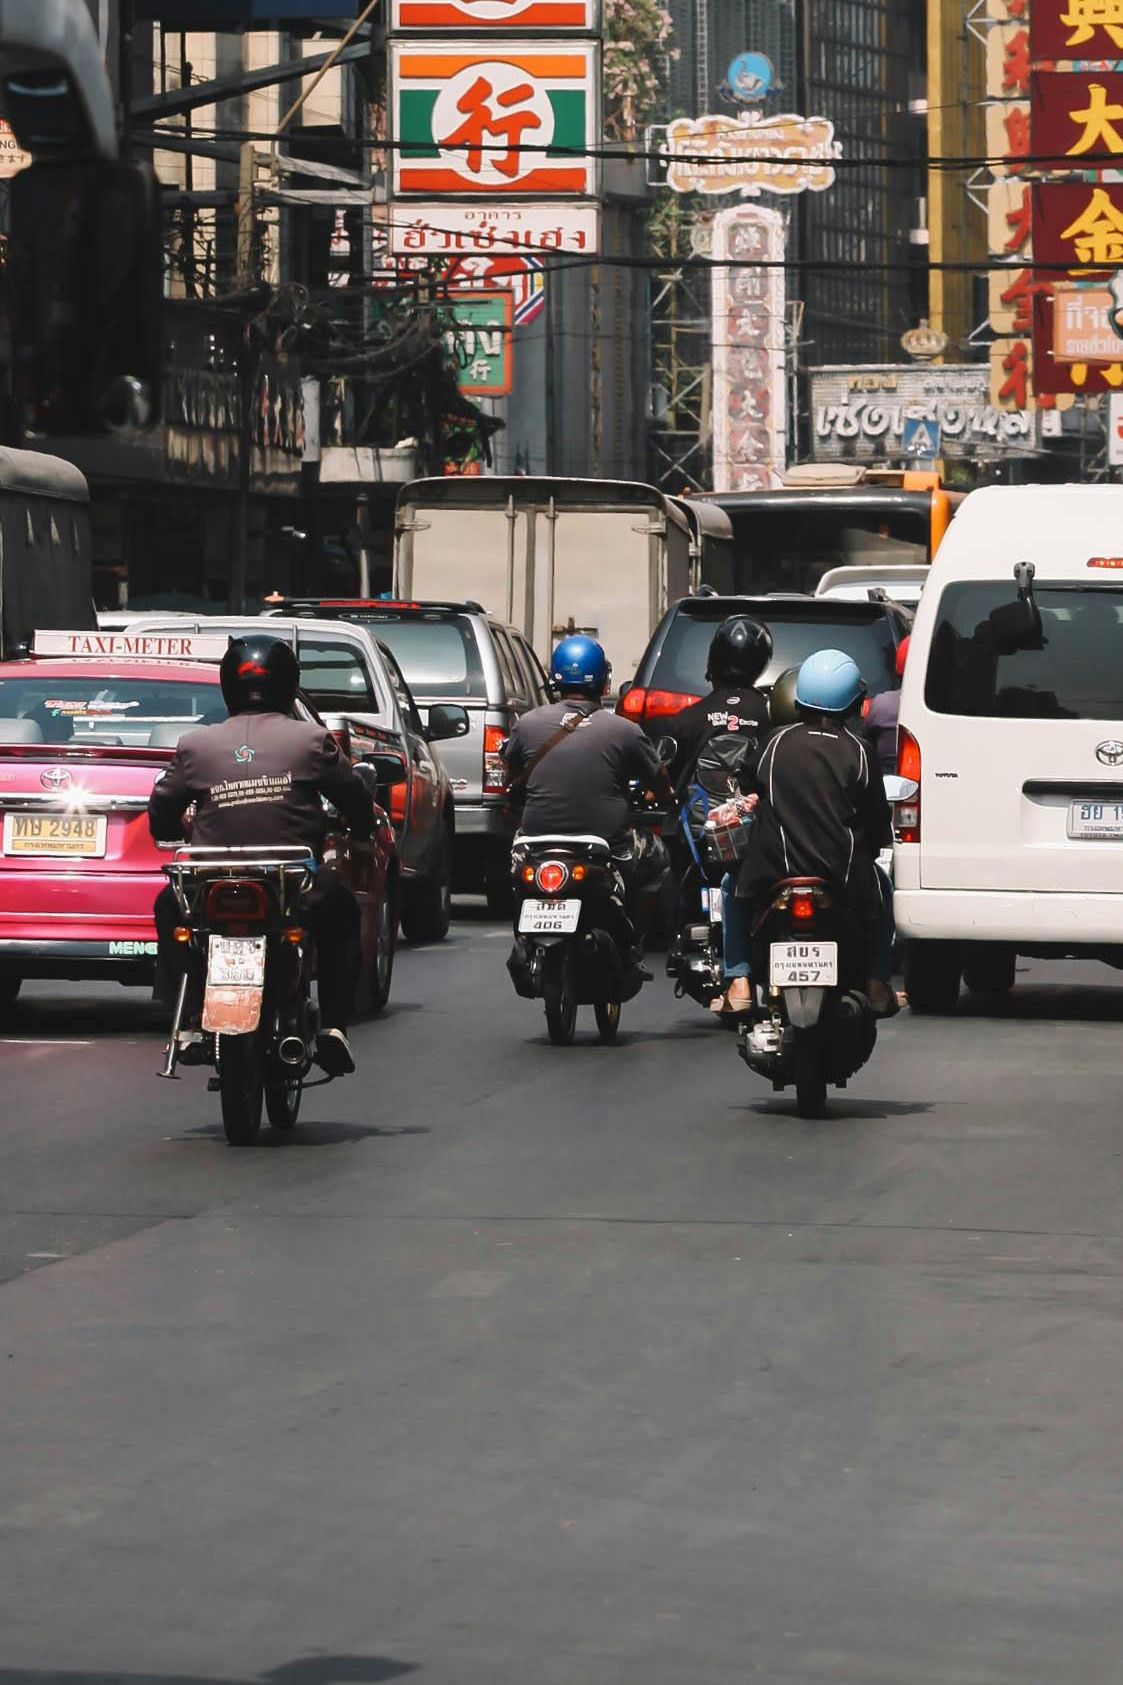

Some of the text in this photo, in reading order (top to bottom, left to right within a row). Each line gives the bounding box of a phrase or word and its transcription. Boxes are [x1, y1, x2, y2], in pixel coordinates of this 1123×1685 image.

[465, 211, 522, 220] อาคาร
[68, 636, 193, 656] TAXI-METER
[50, 818, 95, 838] 2948
[534, 921, 563, 930] 406
[787, 971, 821, 982] 457
